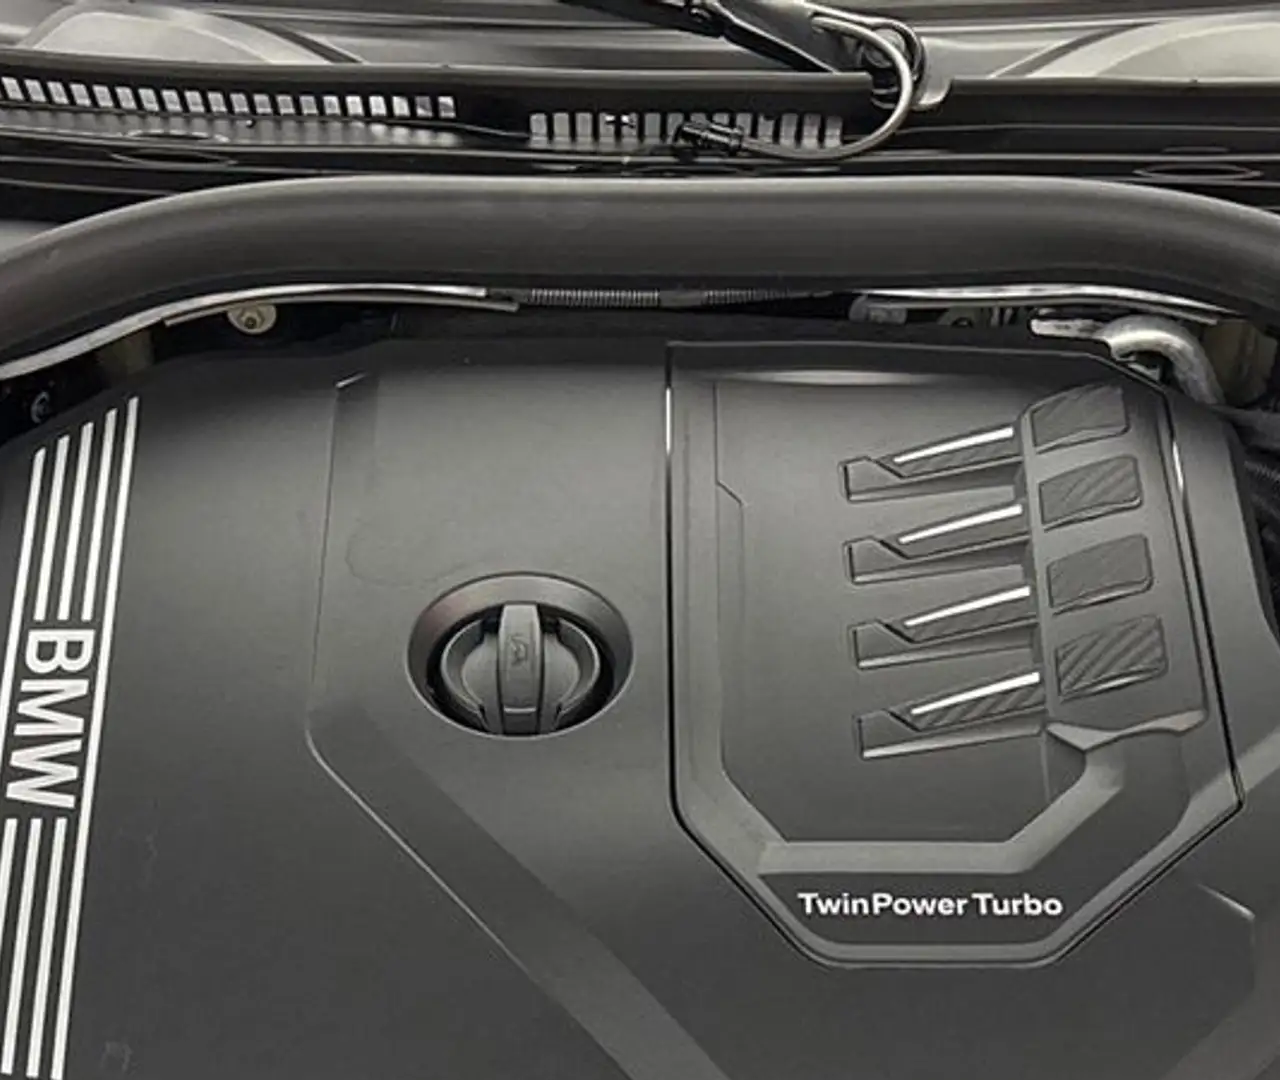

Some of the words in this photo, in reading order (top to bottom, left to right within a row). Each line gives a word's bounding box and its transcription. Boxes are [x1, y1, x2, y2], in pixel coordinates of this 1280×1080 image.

[5, 629, 96, 809] BMW
[797, 891, 968, 916] TwinPower
[971, 891, 1063, 916] Turbo
